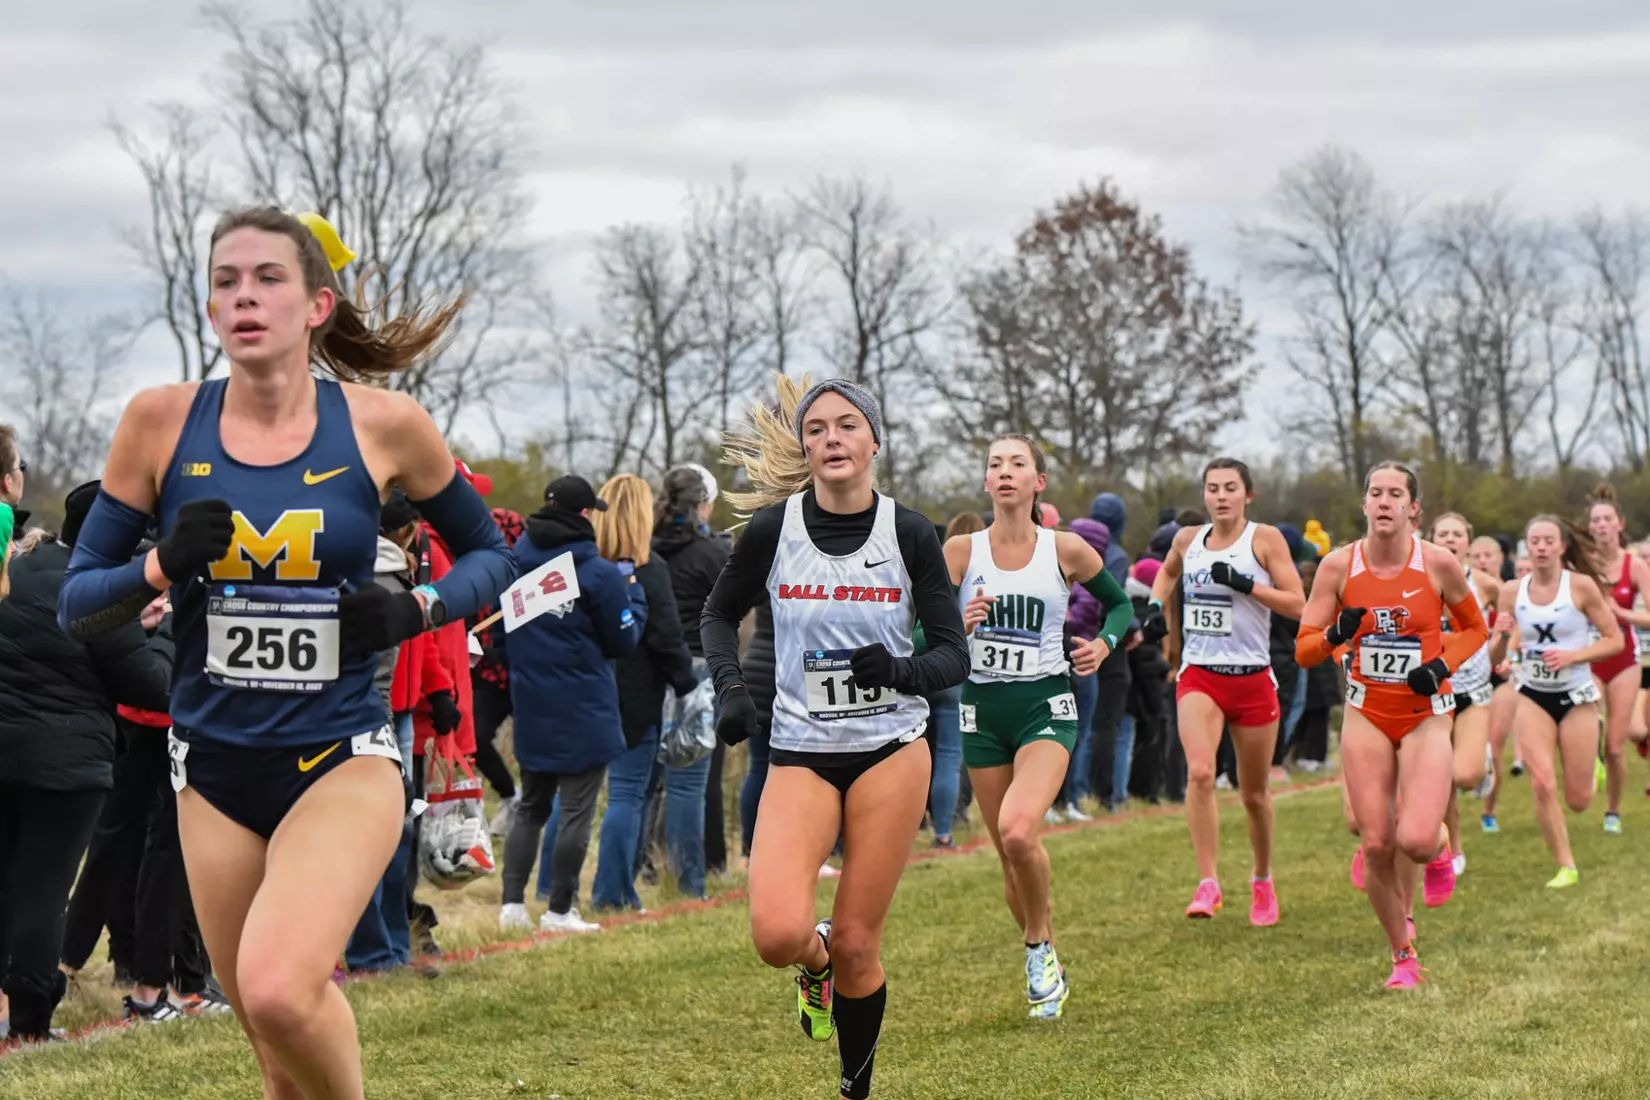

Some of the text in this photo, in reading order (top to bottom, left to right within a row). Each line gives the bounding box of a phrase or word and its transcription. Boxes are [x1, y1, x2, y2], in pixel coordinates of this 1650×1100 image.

[207, 508, 324, 580] M
[778, 584, 903, 603] BALL STATE
[1192, 609, 1223, 628] 153
[1533, 623, 1557, 643] X
[226, 626, 317, 672] 256
[982, 646, 1025, 671] 311
[1370, 653, 1410, 674] 127
